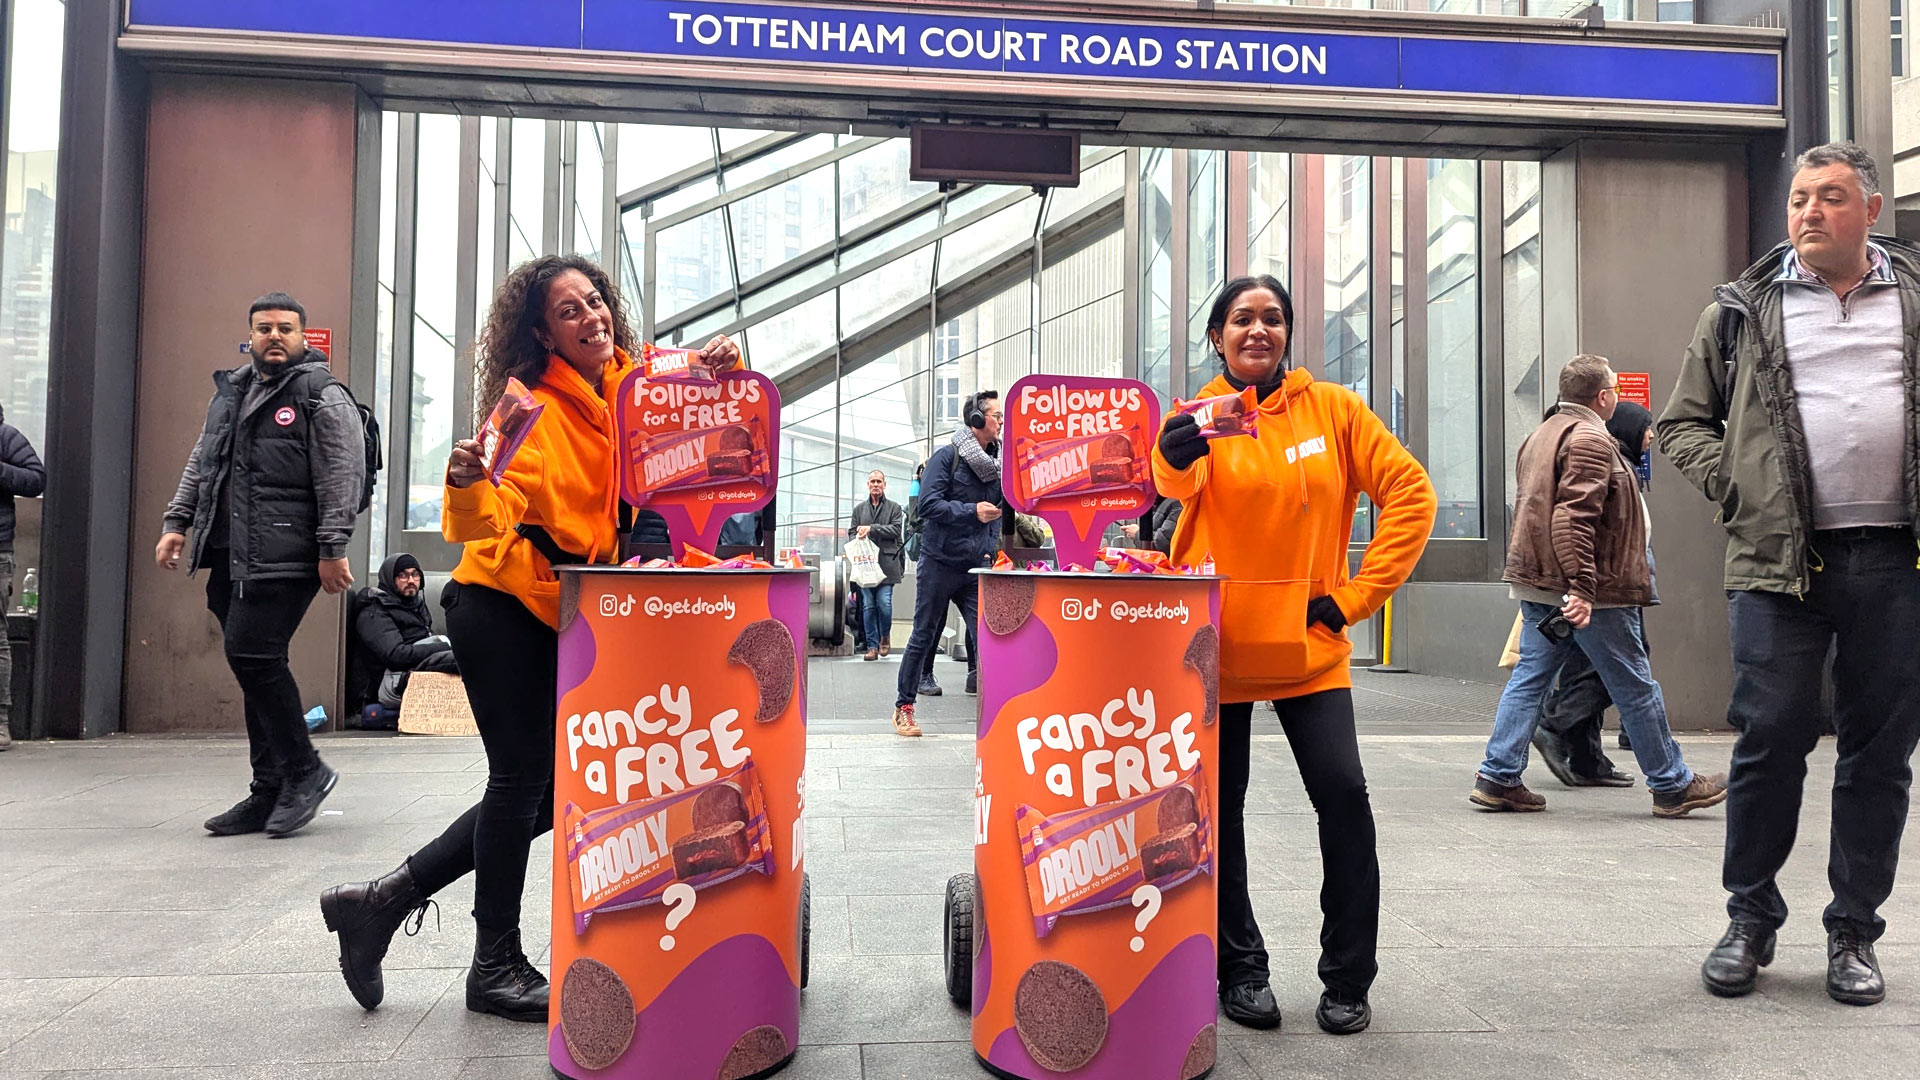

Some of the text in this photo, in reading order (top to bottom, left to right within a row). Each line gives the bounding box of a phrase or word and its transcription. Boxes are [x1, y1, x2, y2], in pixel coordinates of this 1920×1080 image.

[669, 12, 1327, 75] TOTTENHAM COURT ROAD STATION
[634, 377, 722, 408] Follow
[643, 400, 742, 430] for a FREE
[1021, 384, 1140, 416] Follow US
[1029, 409, 1123, 438] for a FREE
[644, 435, 706, 487] DROOLY
[1030, 443, 1088, 493] DROOLY
[719, 491, 756, 500] @getdrooly
[1101, 497, 1137, 507] @getdrooly
[644, 594, 735, 620] @getdrooly
[1110, 599, 1189, 624] @getdrooly
[566, 683, 692, 772] Fancy
[1016, 687, 1156, 775] Fancy
[585, 760, 607, 794] a
[615, 708, 751, 804] FREE
[1045, 763, 1073, 797] a
[1082, 711, 1201, 807] FREE
[578, 808, 669, 903] DROOLY
[1038, 811, 1137, 907] DROOLY
[604, 883, 621, 896] READY
[622, 879, 631, 887] TO
[631, 869, 651, 882] DROOL
[1072, 886, 1090, 899] READY
[1091, 881, 1100, 889] TO
[1101, 871, 1121, 885] DROOL
[660, 883, 697, 951] ?
[1130, 884, 1162, 953] ?
